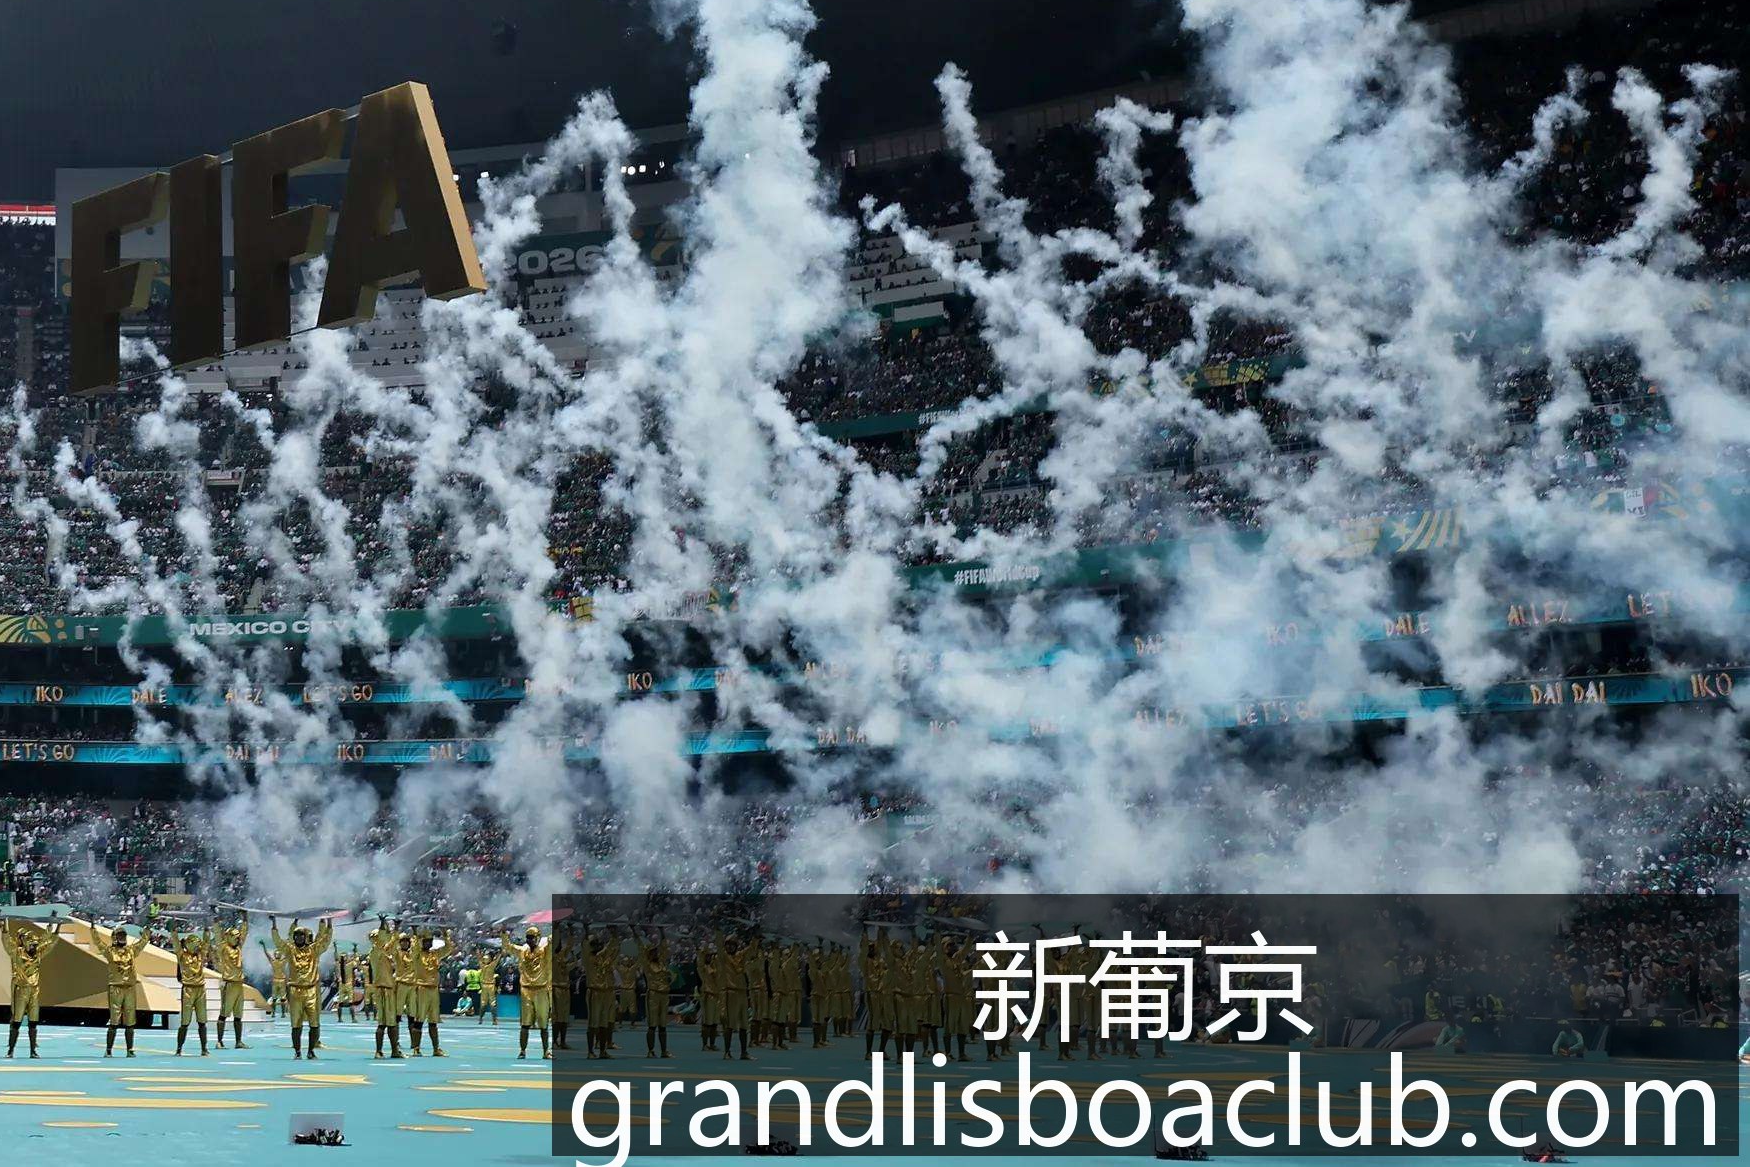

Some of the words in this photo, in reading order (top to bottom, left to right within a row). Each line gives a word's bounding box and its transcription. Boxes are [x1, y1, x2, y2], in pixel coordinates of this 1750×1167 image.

[71, 80, 488, 396] FIFA
[190, 620, 288, 636] MEXICO
[627, 671, 653, 691] IKO
[1690, 672, 1733, 698] IKO
[35, 685, 64, 702] IKO
[351, 684, 373, 702] GO
[1530, 681, 1564, 706] DAI
[1571, 680, 1607, 705] DAI
[2, 743, 48, 761] LET'S
[52, 744, 76, 761] GO
[336, 744, 365, 762] IKO
